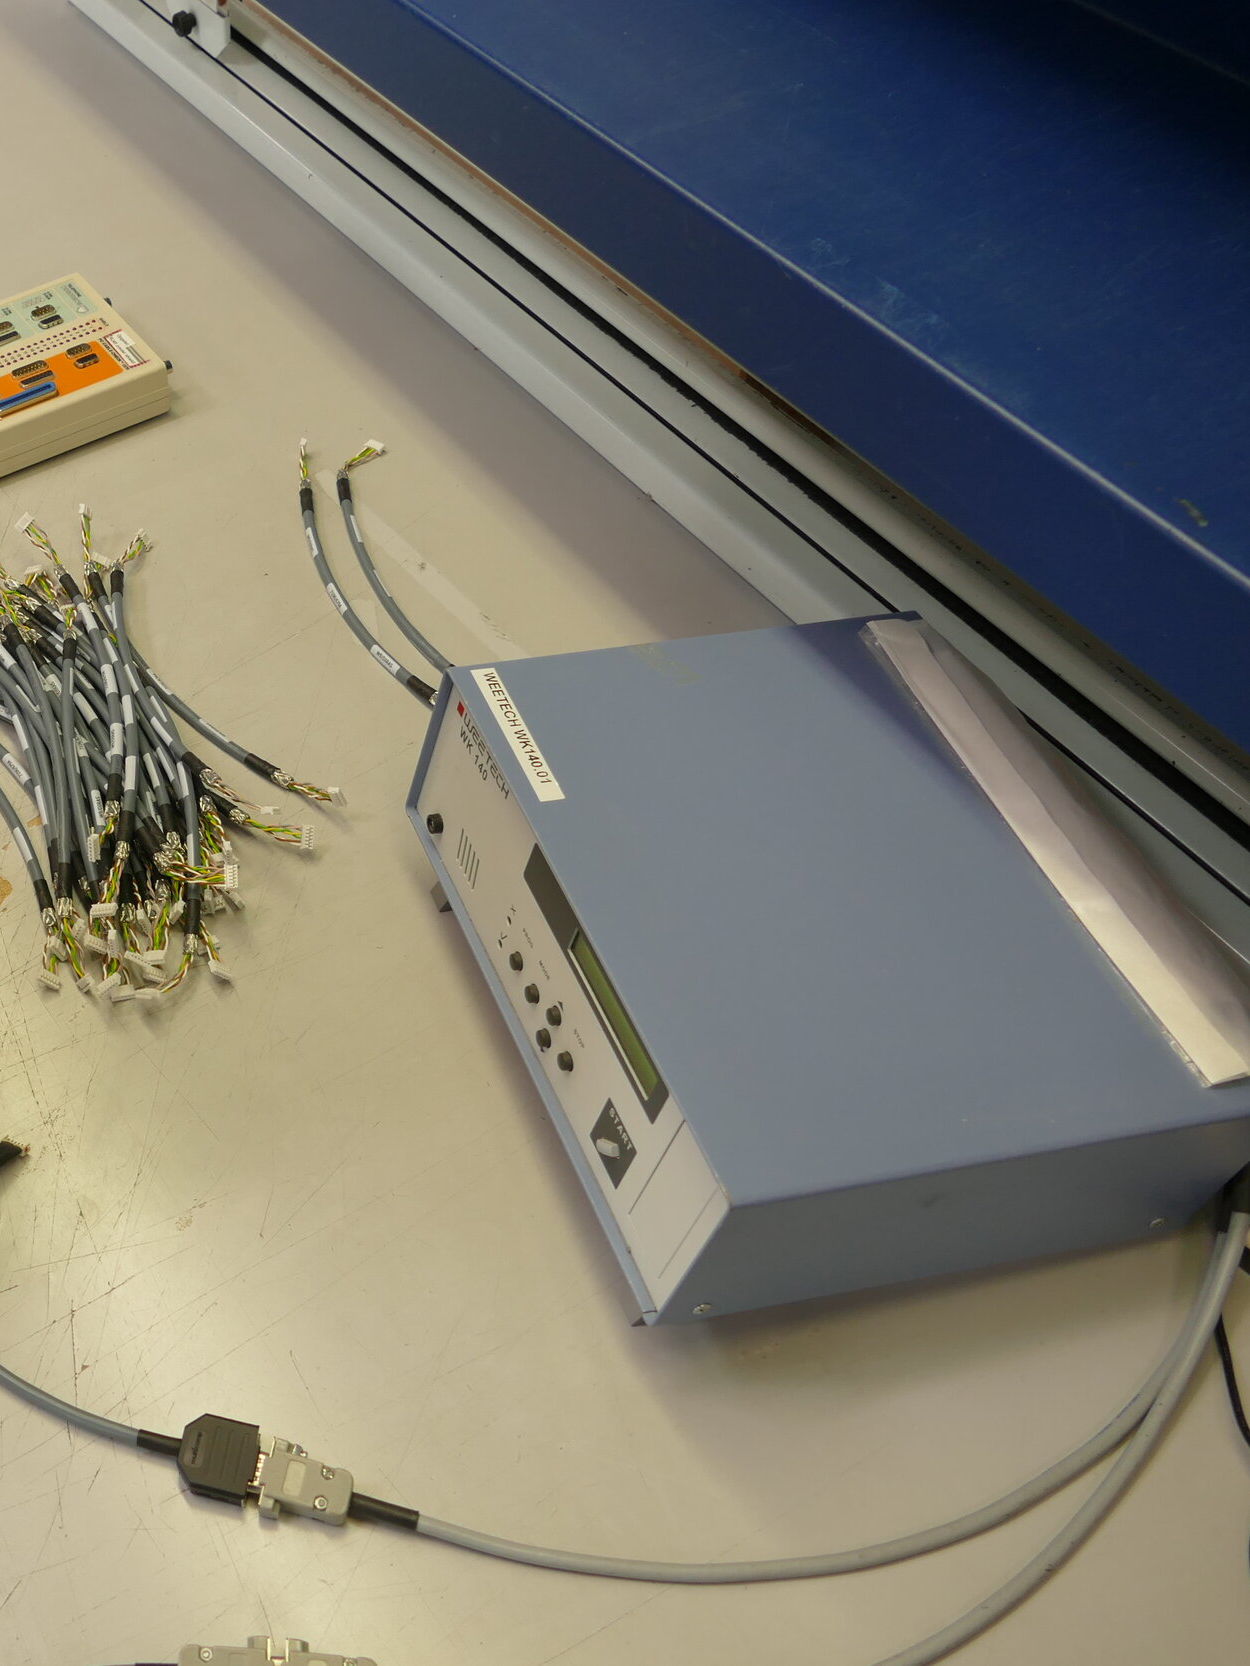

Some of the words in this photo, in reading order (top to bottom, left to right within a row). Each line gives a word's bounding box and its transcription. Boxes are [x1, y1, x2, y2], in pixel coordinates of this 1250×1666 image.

[460, 726, 473, 755] WK
[474, 755, 488, 781] 140
[463, 713, 510, 800] WEETECH
[483, 672, 521, 727] WEETECH
[514, 729, 552, 784] WK140.01
[609, 1107, 633, 1150] START
